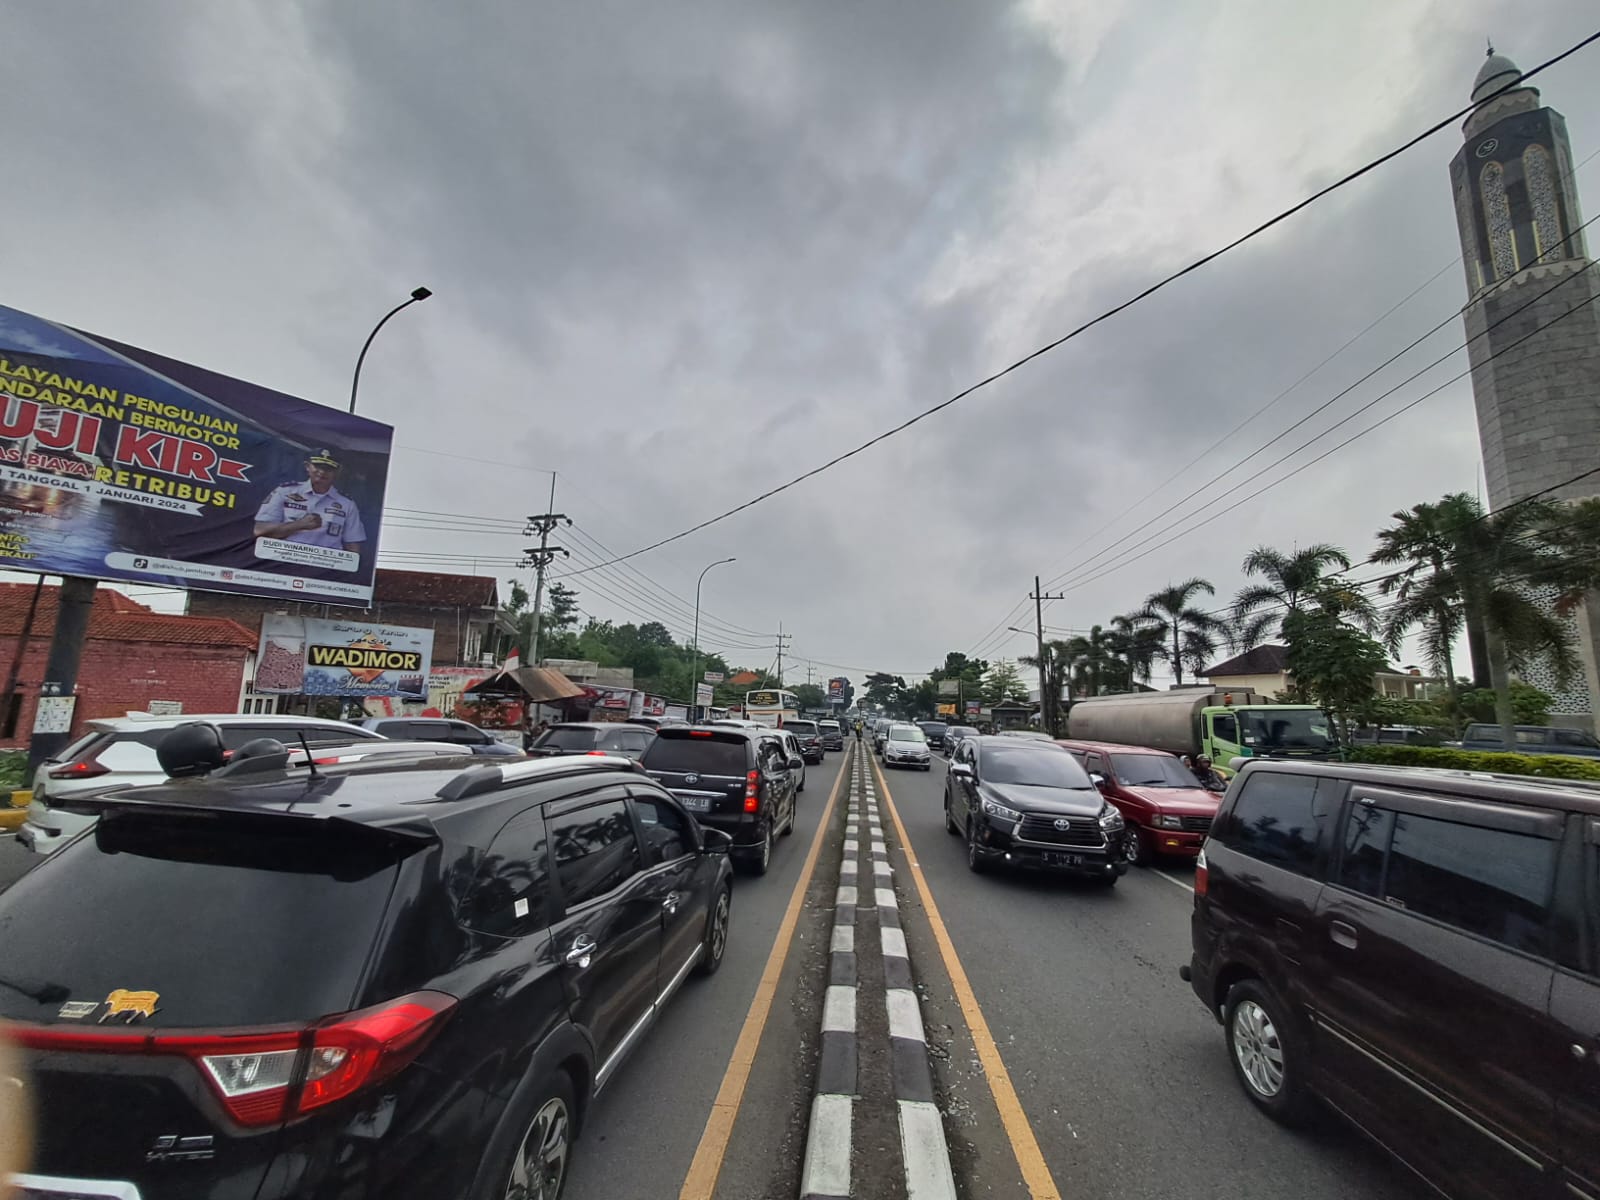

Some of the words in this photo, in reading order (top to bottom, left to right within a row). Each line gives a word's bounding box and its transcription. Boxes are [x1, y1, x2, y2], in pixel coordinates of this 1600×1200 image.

[123, 393, 238, 434] PENGUJIAN
[130, 411, 241, 450] BERMOTOR
[0, 393, 102, 456] UJI
[113, 424, 216, 483] KIR
[8, 470, 80, 490] TANGGAL
[96, 488, 154, 504] JANUARI
[158, 499, 187, 511] 2024
[25, 452, 89, 477] BIAYA
[95, 466, 237, 509] RETRIBUSI
[263, 540, 282, 548] BUDI
[313, 646, 416, 670] WADIMOR
